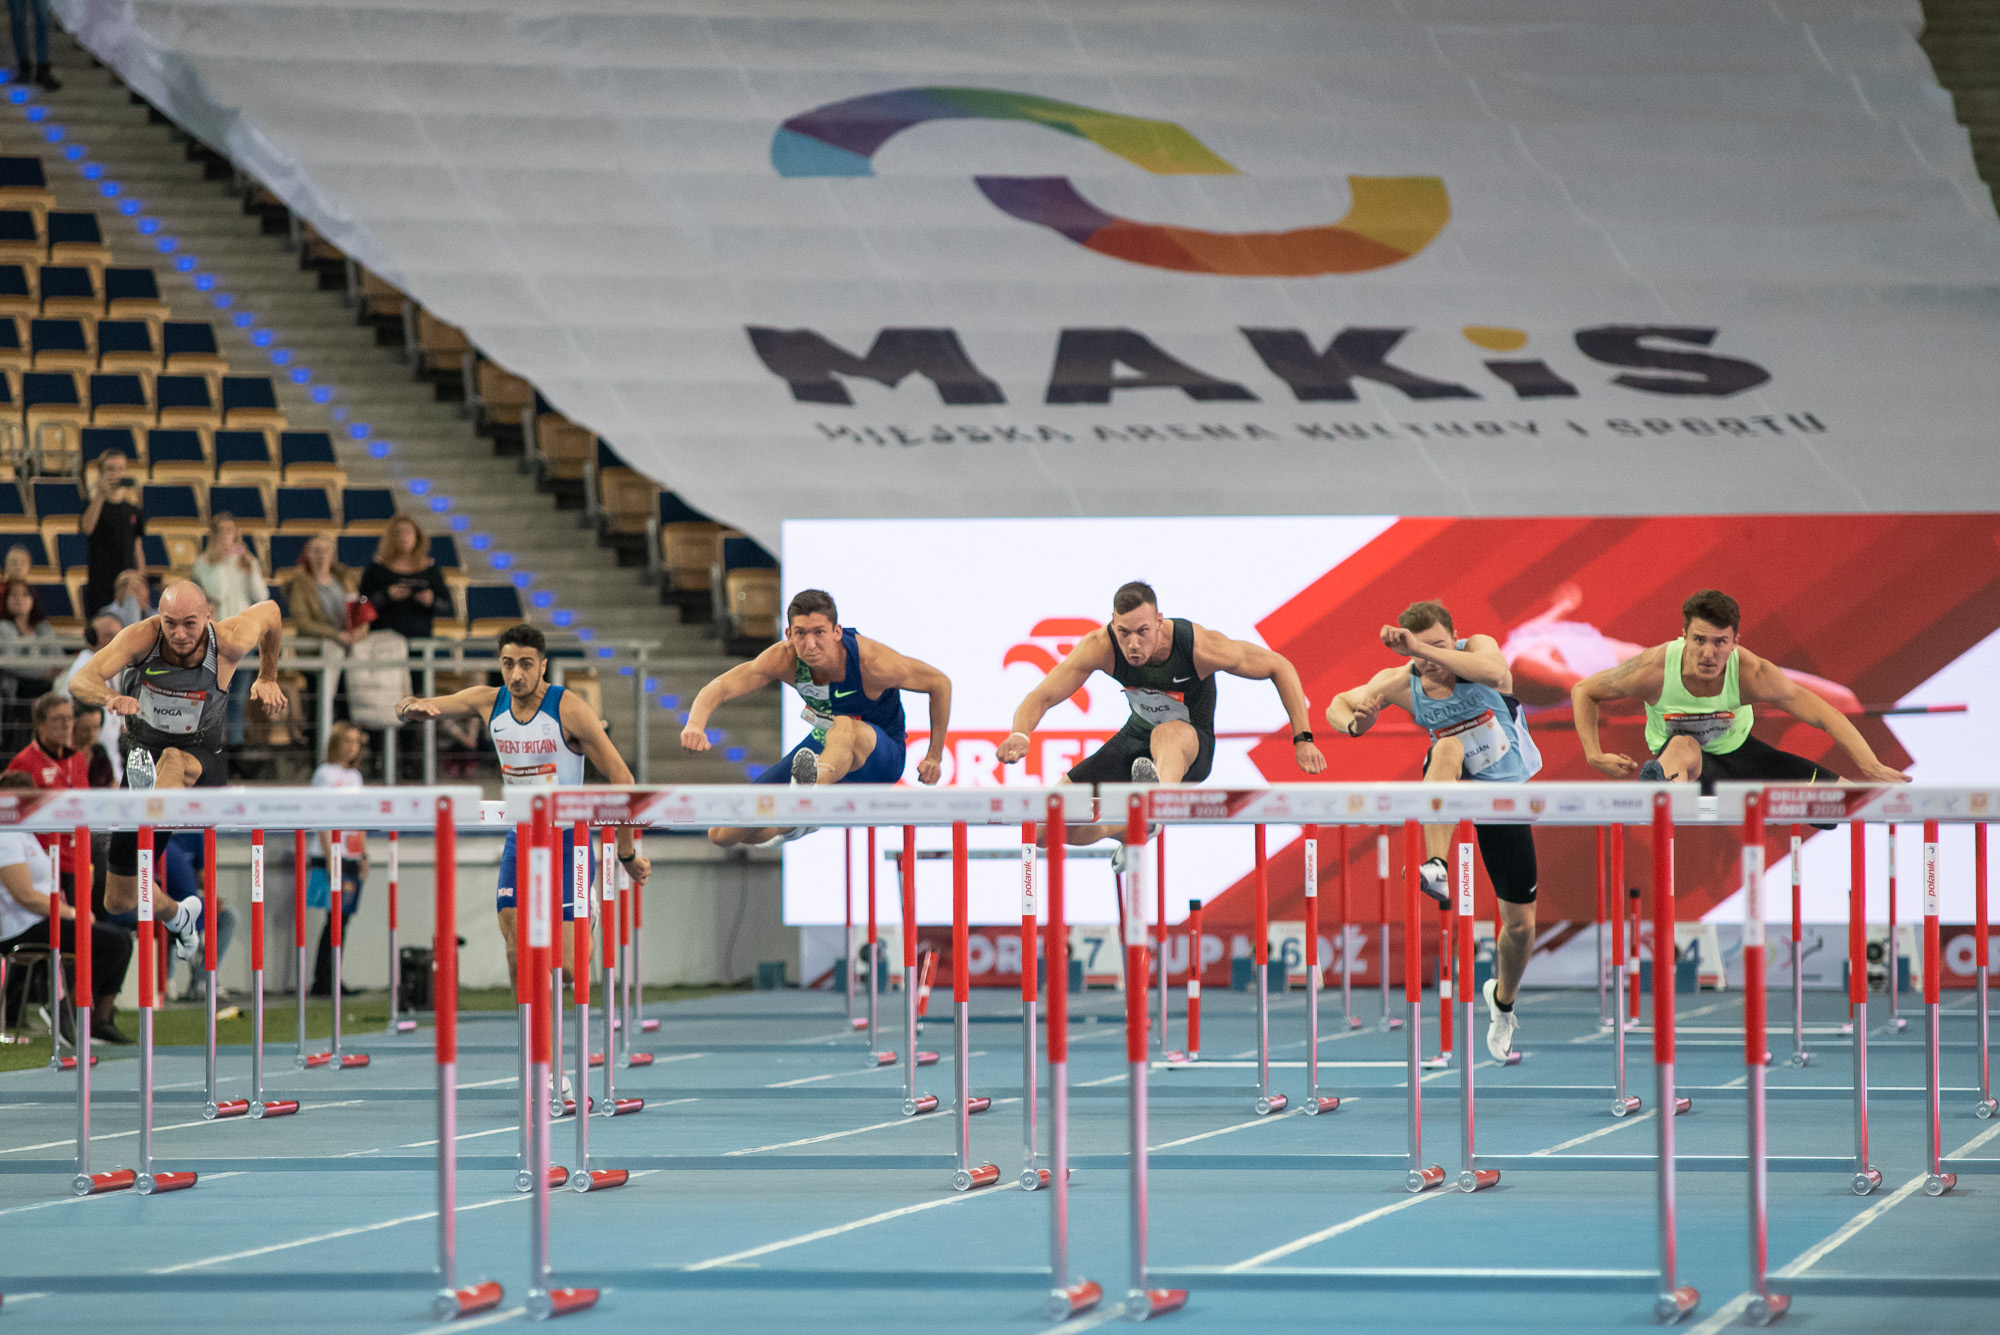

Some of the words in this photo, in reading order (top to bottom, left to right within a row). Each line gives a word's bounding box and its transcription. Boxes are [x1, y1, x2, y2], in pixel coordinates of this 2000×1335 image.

[743, 323, 1772, 405] MAKiS
[813, 420, 1074, 447] MIEJSKA
[1093, 422, 1278, 443] ARENA
[1295, 419, 1541, 443] KULTURY
[1563, 418, 1591, 437] I
[1603, 411, 1829, 437] SPORTU
[153, 706, 183, 717] NOGA
[495, 739, 520, 754] GREAT
[522, 739, 557, 754] BRITAIN
[902, 737, 1108, 788] ORLE
[139, 867, 150, 903] polanik
[576, 863, 585, 899] polanik
[1024, 861, 1033, 897] polanik
[1461, 861, 1471, 897] polanik
[1927, 860, 1936, 897] polanik
[1084, 937, 1104, 969] 7
[1281, 937, 1300, 969] 6
